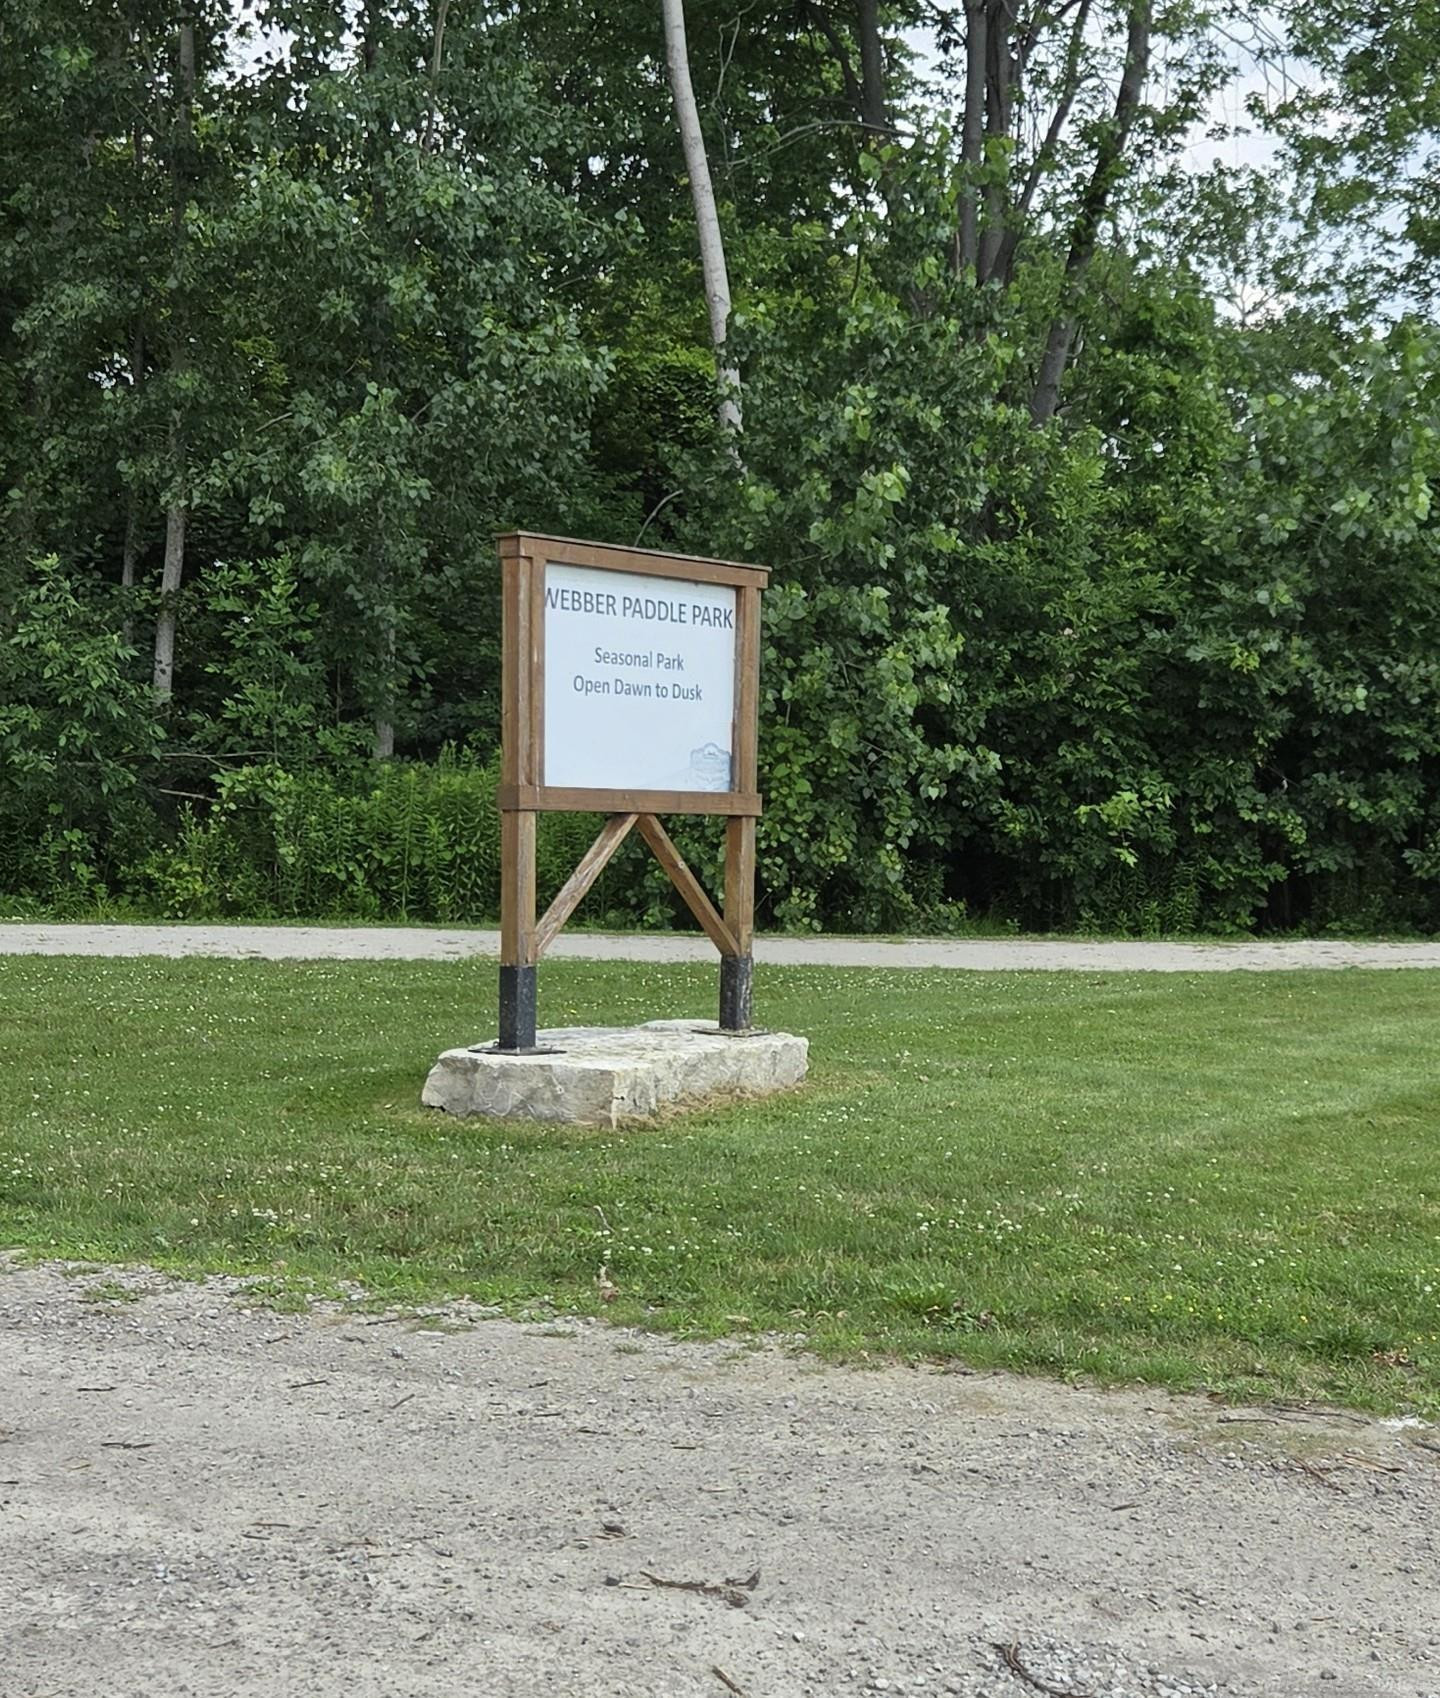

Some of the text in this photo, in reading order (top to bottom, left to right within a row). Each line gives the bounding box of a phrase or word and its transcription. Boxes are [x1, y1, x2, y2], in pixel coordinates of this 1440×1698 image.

[545, 587, 733, 629] WEBBER PADDLE PARK
[594, 647, 684, 671] Seasonal Park
[573, 675, 702, 701] Open Dawn to Dusk
